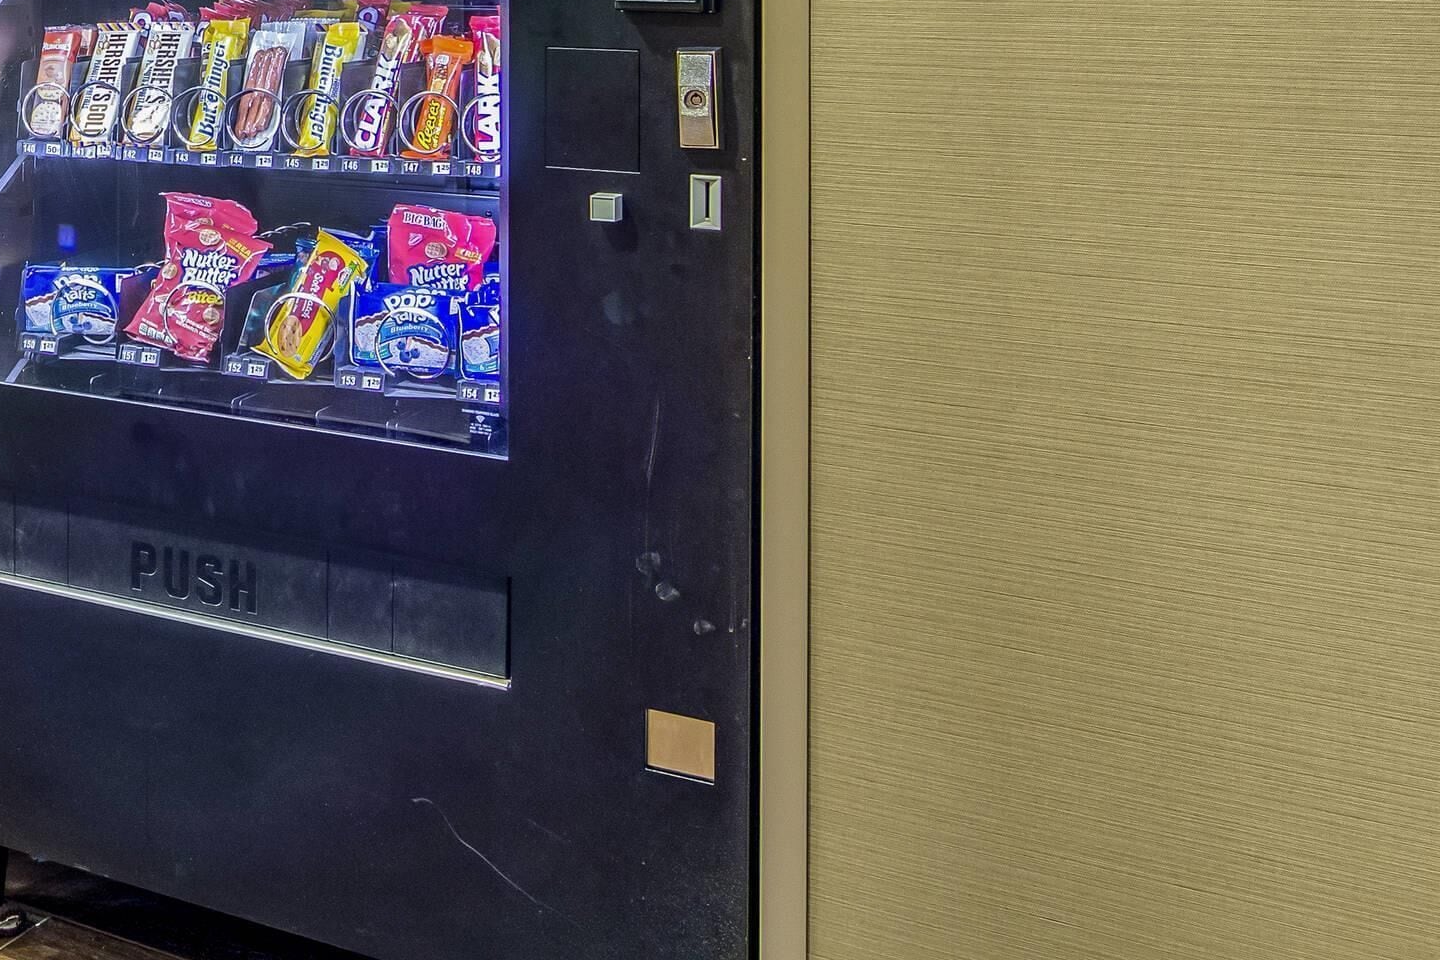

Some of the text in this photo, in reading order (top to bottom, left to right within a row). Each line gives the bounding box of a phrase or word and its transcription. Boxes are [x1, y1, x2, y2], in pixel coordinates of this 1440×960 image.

[355, 52, 397, 150] CLARK
[417, 99, 441, 150] Reese's
[123, 149, 137, 159] 142
[175, 153, 189, 162] 143
[229, 156, 243, 165] 144
[285, 158, 300, 168] 145
[343, 161, 358, 170] 146
[403, 162, 419, 173] 147
[465, 165, 482, 176] 148
[403, 211, 446, 230] BIG BAG
[183, 248, 237, 270] Nutter
[182, 266, 237, 287] Butter
[409, 263, 465, 286] Nutter
[64, 286, 97, 303] tarts
[390, 323, 429, 334] Blueberry
[22, 339, 36, 349] 150
[122, 351, 135, 361] 151
[228, 362, 242, 372] 152
[341, 375, 356, 385] 153
[462, 388, 478, 399] 154
[131, 541, 258, 615] PUSH
